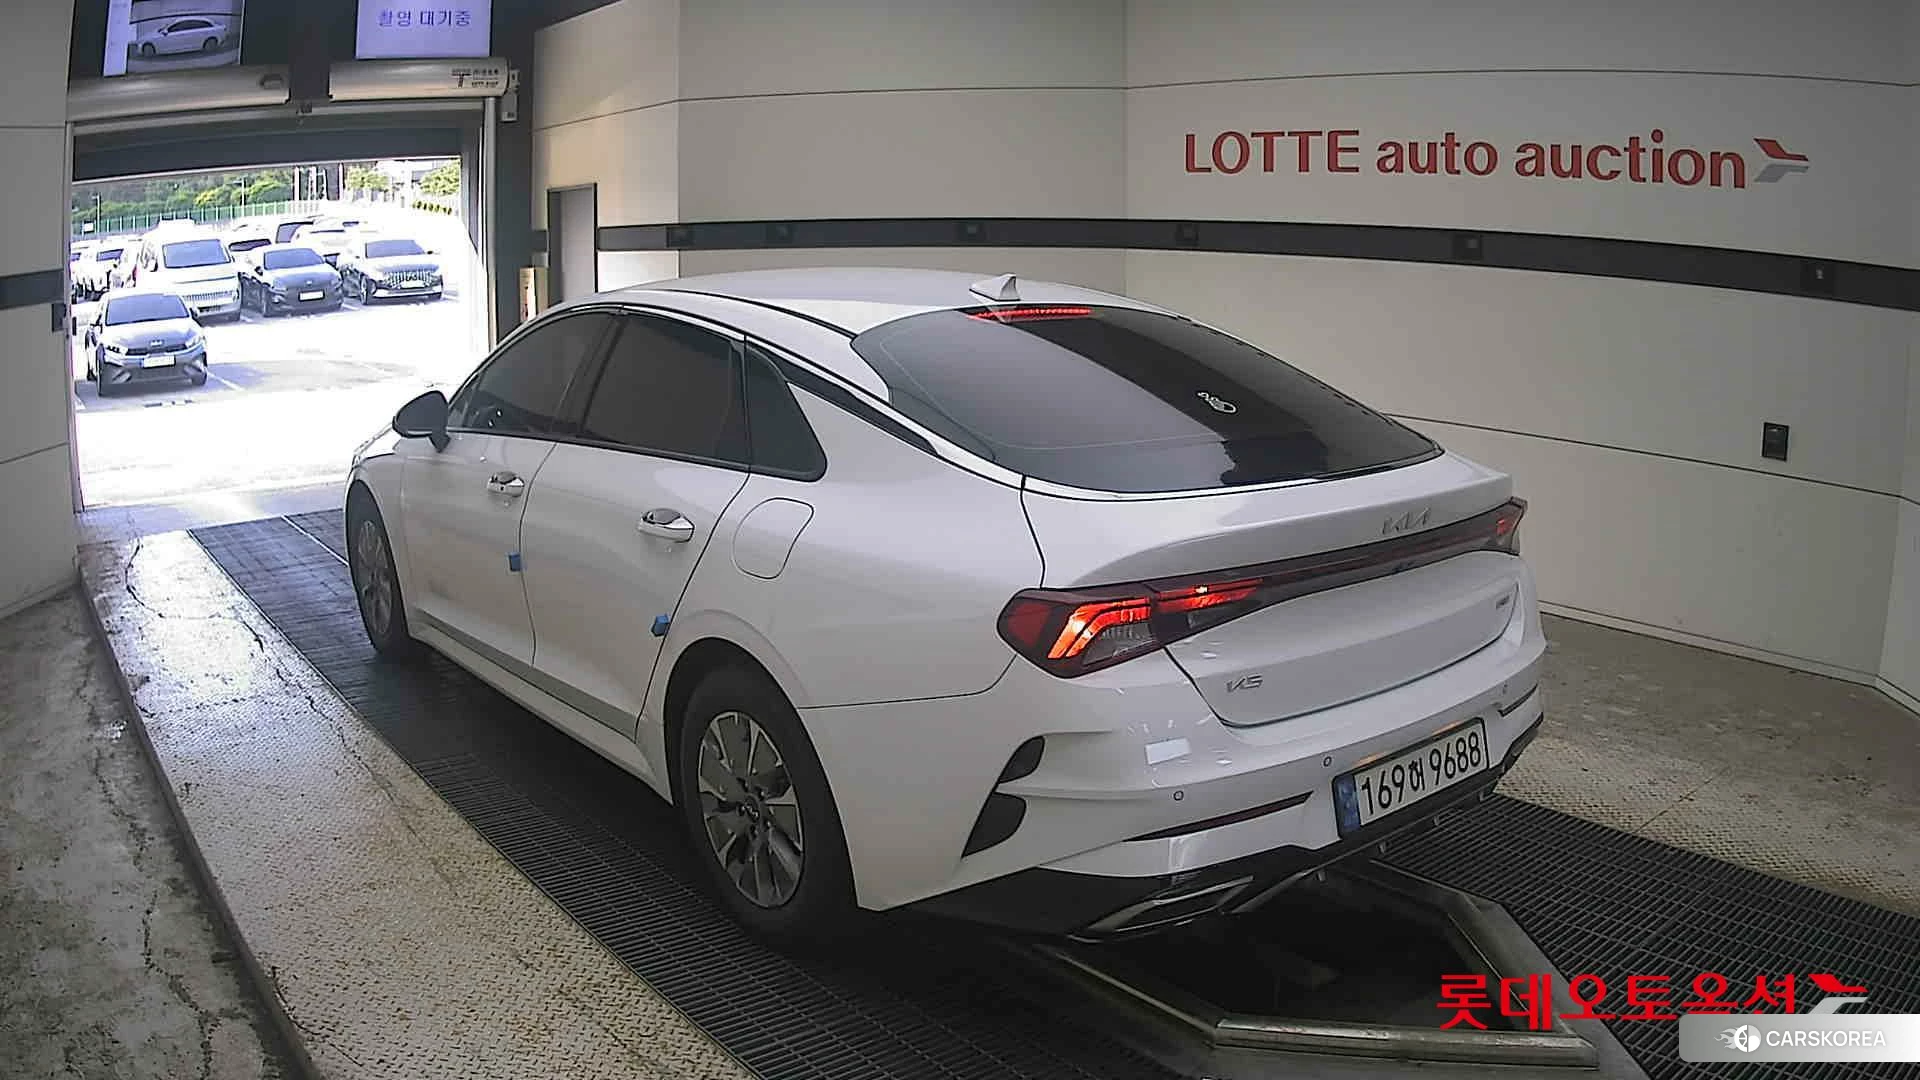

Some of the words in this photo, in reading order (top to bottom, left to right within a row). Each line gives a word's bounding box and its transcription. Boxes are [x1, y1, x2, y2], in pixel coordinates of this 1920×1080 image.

[419, 9, 472, 27] 대기중
[1184, 129, 1360, 174] LOTTE
[1376, 131, 1498, 176] auto
[1514, 128, 1746, 189] auction
[1429, 731, 1482, 786] 9688
